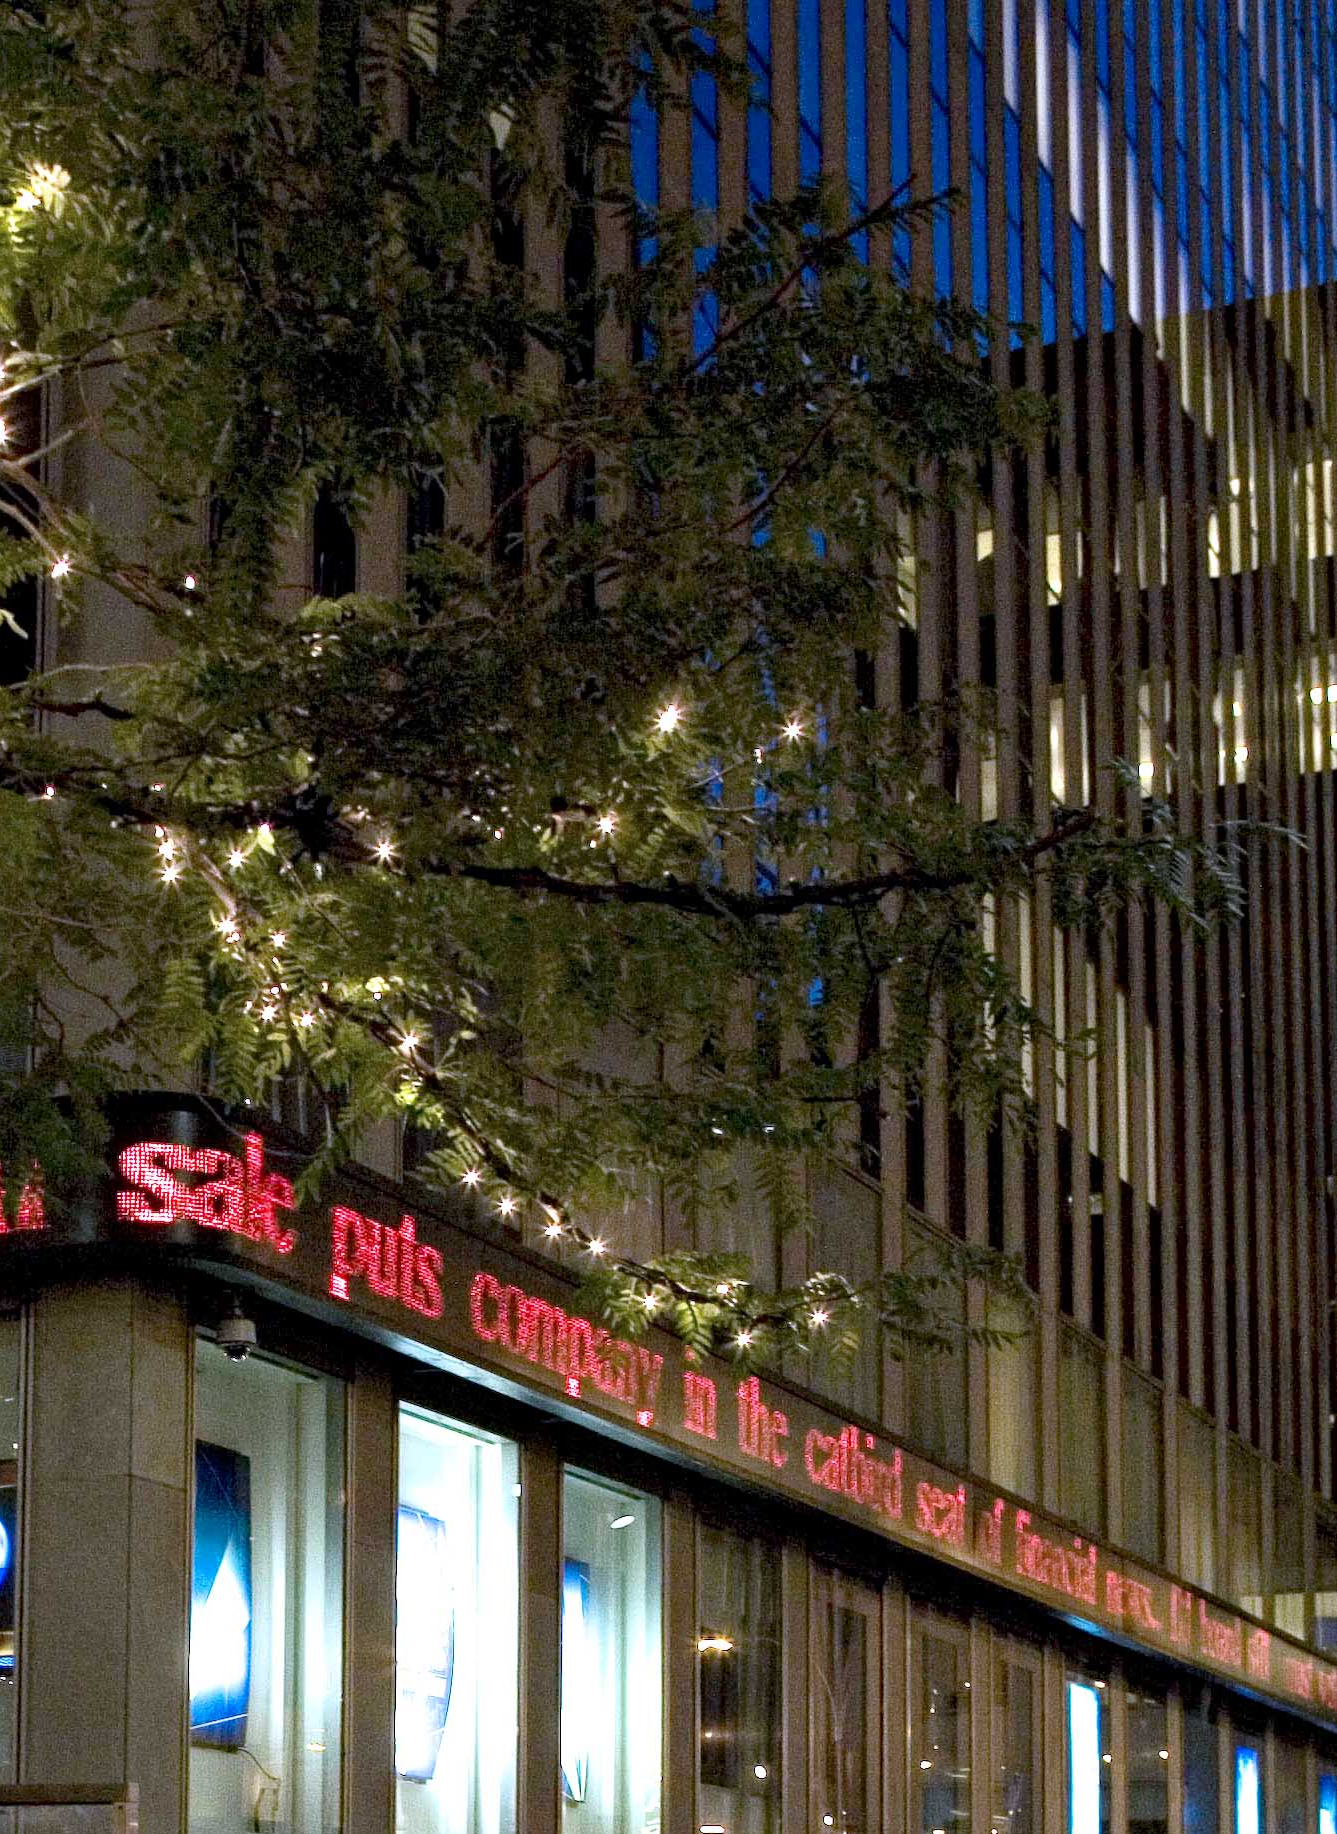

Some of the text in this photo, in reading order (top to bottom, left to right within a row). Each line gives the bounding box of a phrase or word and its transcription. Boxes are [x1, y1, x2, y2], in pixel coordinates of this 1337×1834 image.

[328, 1206, 443, 1319] puts
[470, 1273, 663, 1427] company
[736, 1376, 789, 1469] the
